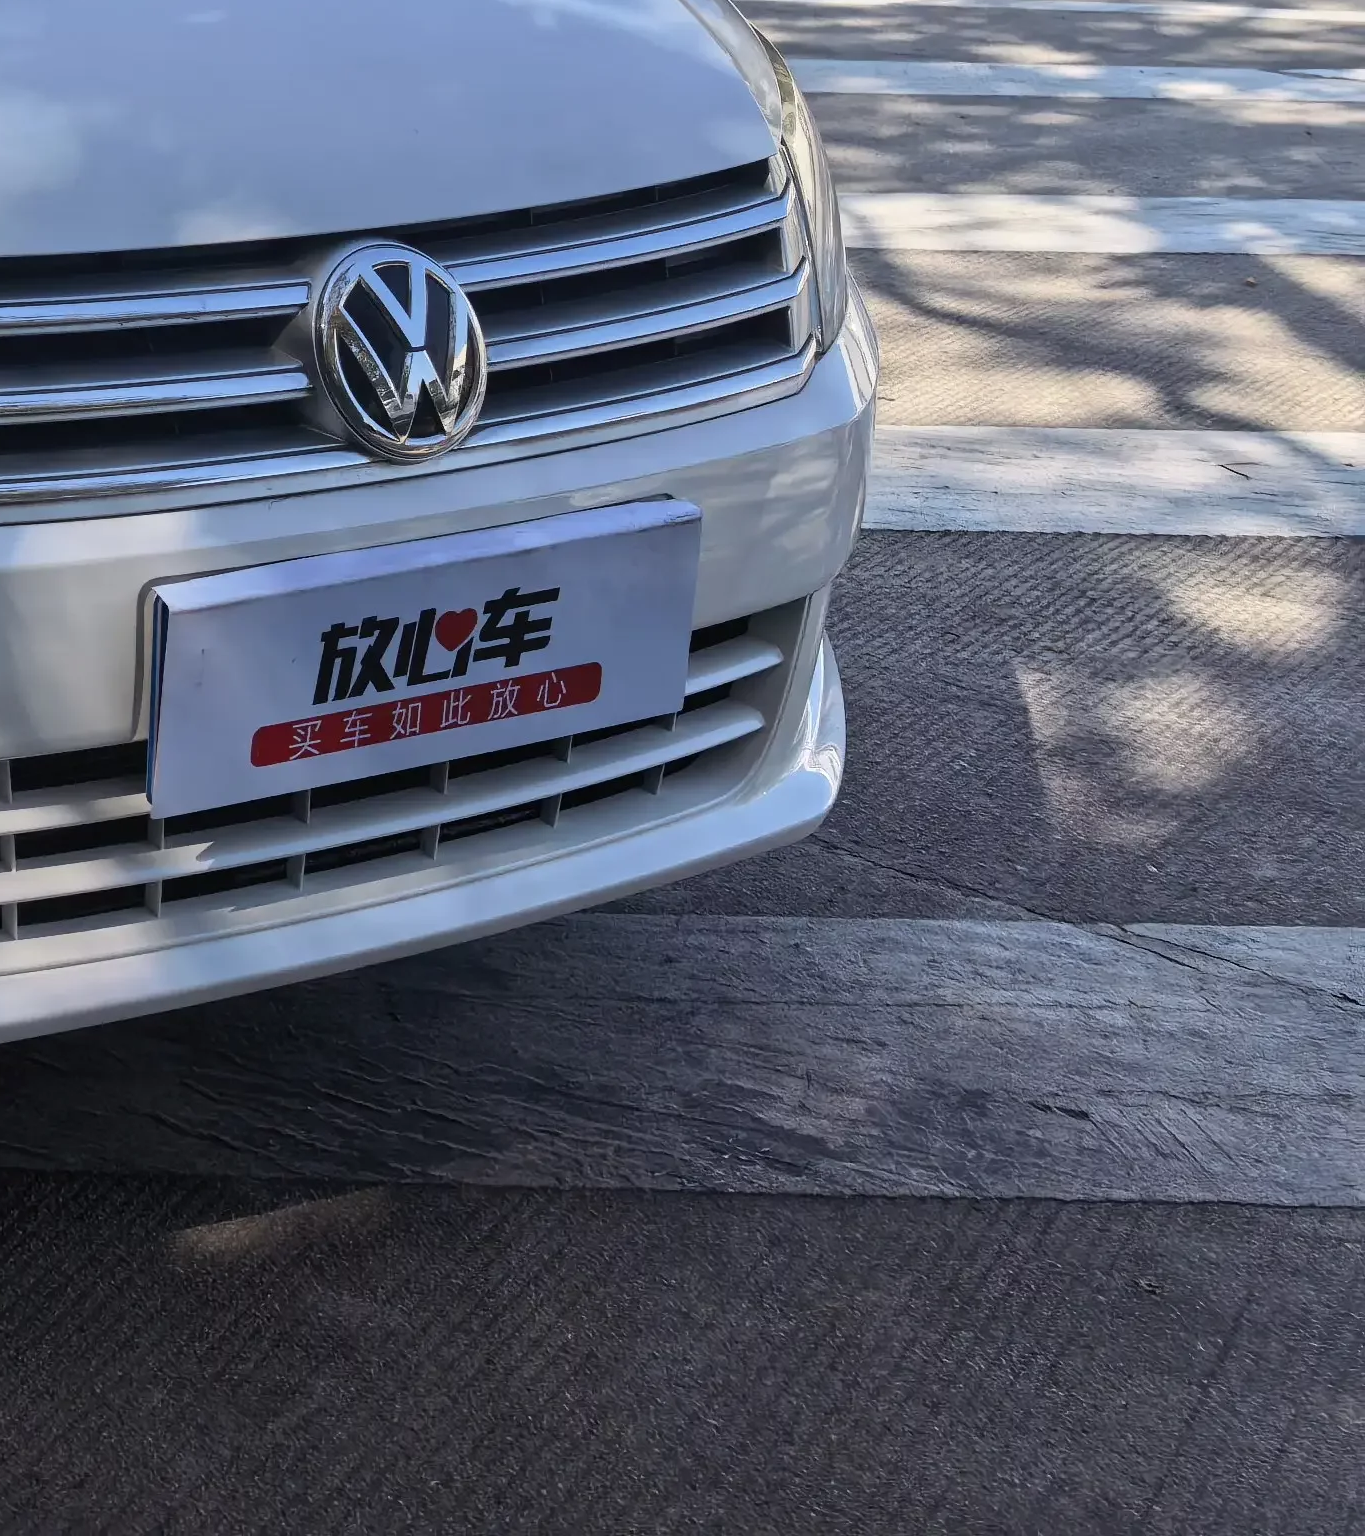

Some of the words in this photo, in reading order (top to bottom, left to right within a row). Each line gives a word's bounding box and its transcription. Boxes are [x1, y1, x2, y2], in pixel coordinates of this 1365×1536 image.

[312, 587, 560, 705] 放心车
[288, 672, 568, 760] 买车如此放心
